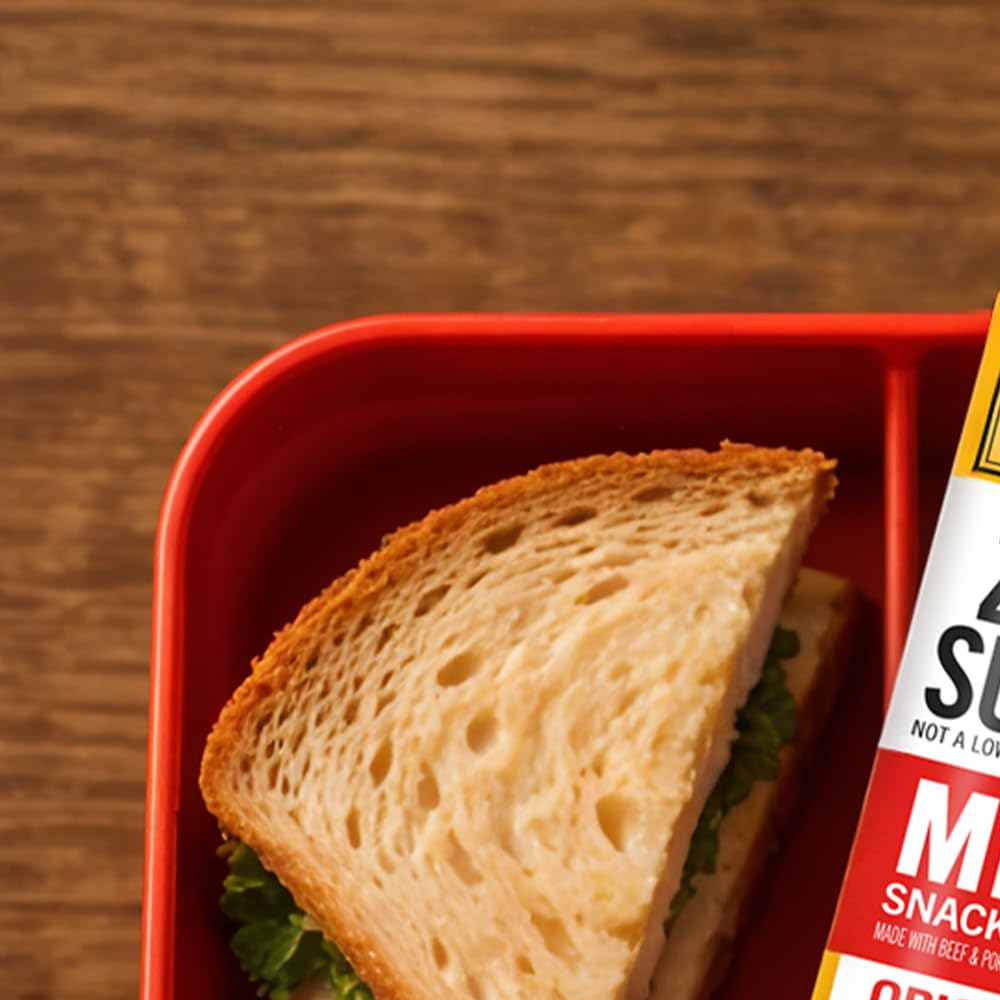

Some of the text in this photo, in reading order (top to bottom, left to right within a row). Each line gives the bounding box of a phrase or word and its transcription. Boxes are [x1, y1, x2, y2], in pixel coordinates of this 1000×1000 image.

[911, 719, 950, 744] NOT
[953, 734, 965, 749] A
[873, 921, 907, 948] MADE
[908, 931, 938, 955] WITH
[938, 939, 972, 962] BEEF
[969, 948, 979, 966] &
